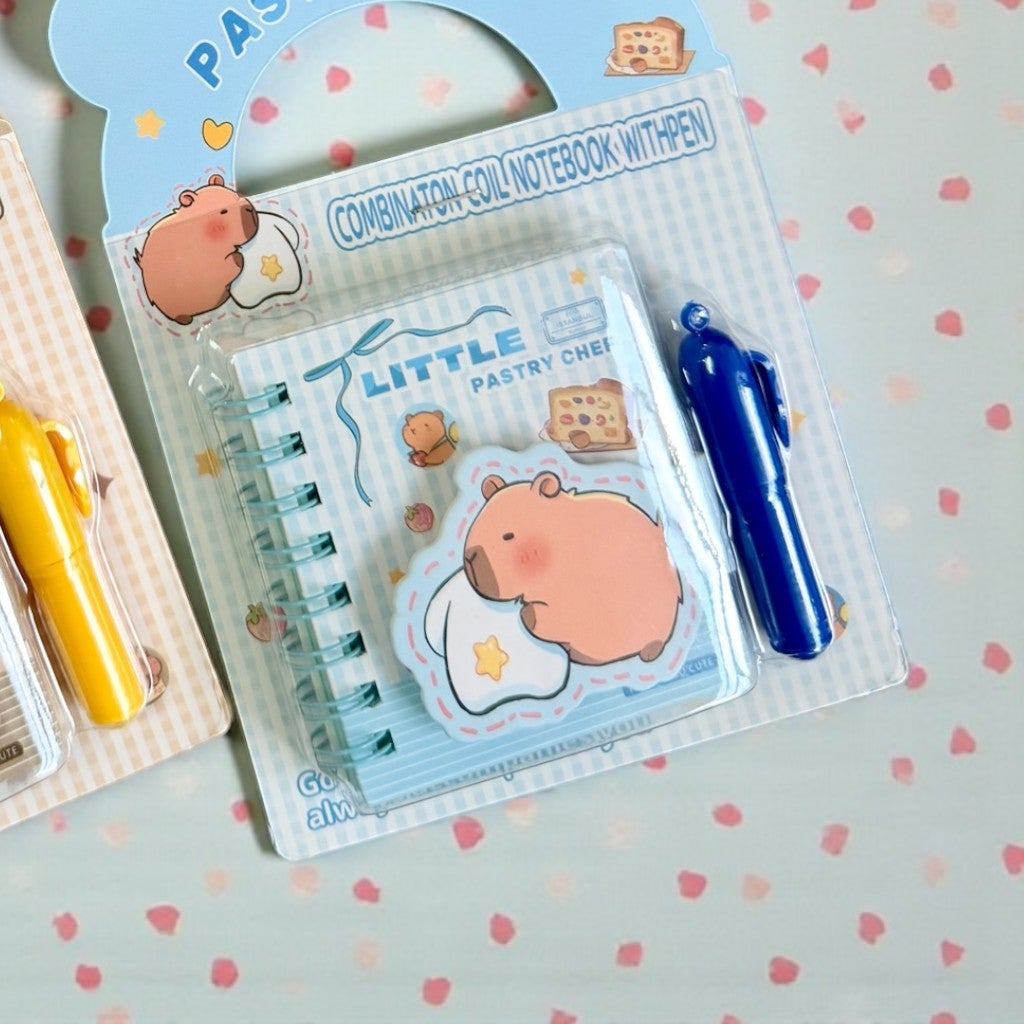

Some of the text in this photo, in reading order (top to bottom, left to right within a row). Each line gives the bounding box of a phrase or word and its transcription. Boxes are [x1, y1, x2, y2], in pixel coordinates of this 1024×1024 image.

[335, 106, 709, 243] COMBINATON COIL NOTEBOOK WITHPEN
[360, 326, 526, 398] LITTLE
[470, 354, 553, 393] PASTRY
